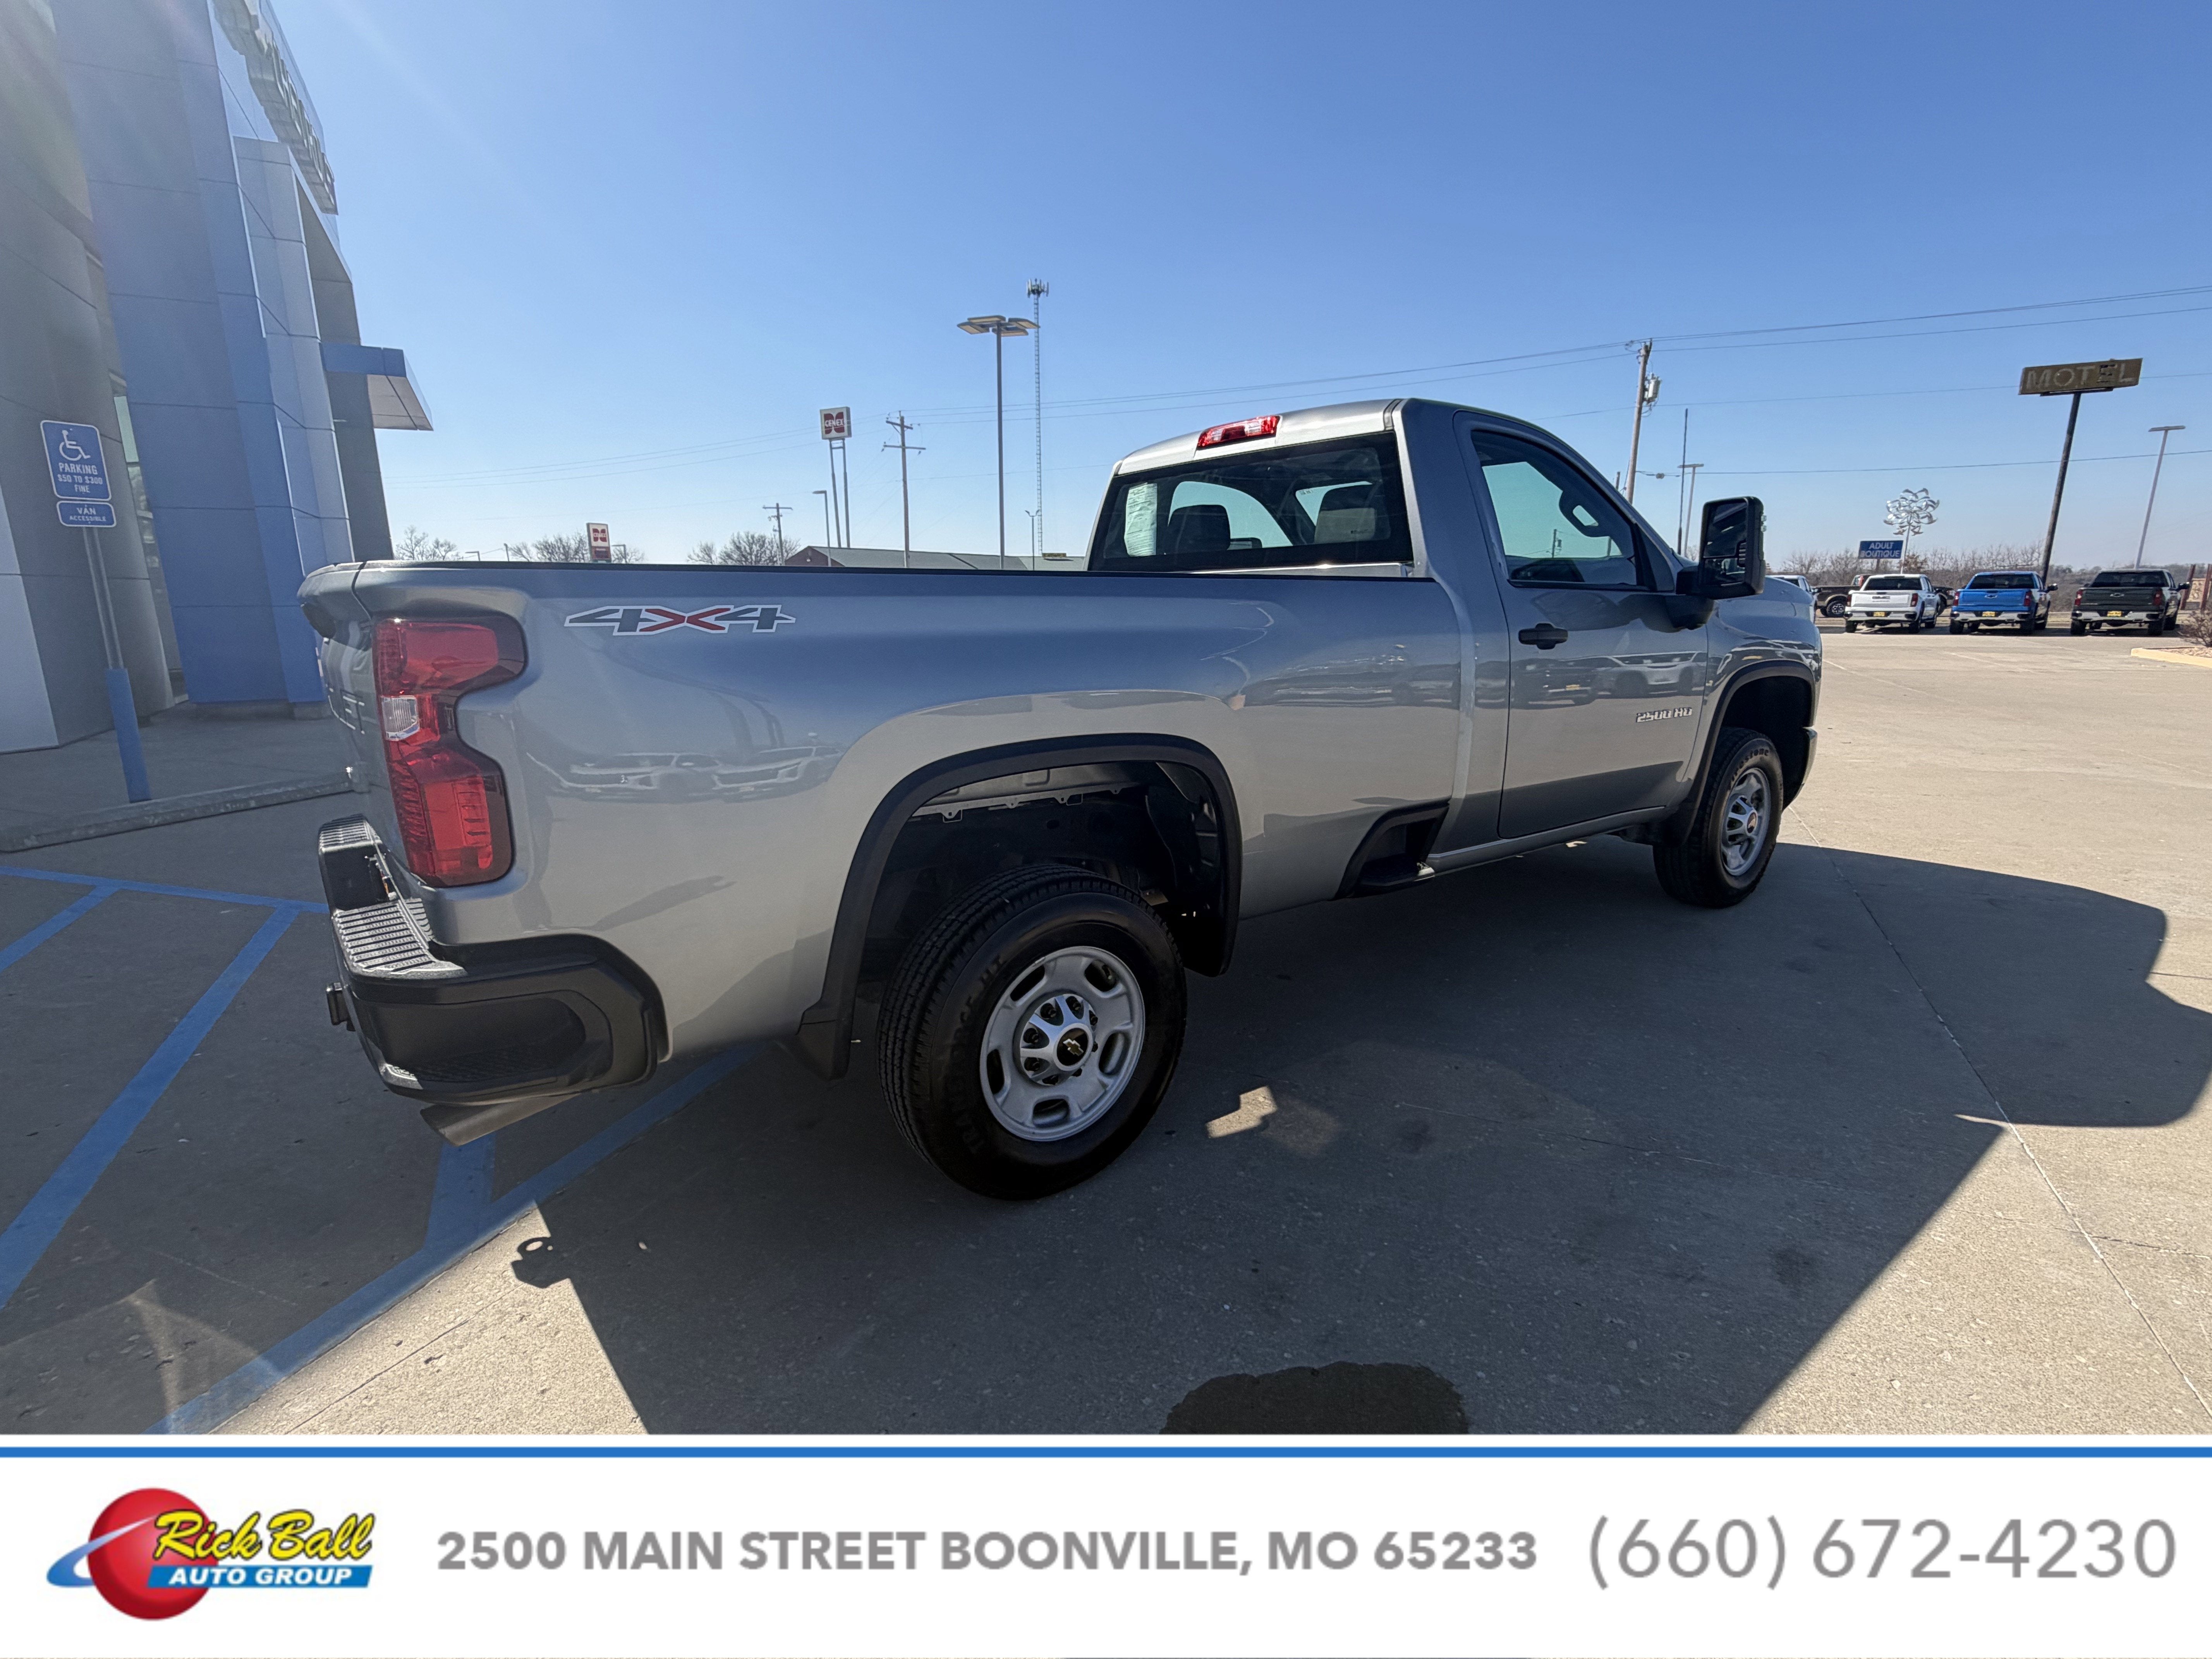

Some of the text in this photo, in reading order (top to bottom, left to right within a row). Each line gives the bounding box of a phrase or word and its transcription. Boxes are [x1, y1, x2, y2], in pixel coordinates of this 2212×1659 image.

[2026, 363, 2134, 388] MOTEL
[825, 419, 844, 427] CENEX
[58, 462, 98, 475] PARKING
[58, 474, 103, 484] $50 TO $300
[74, 484, 90, 493] FINE
[76, 507, 96, 515] VAN
[1636, 707, 1692, 723] 2500 HD
